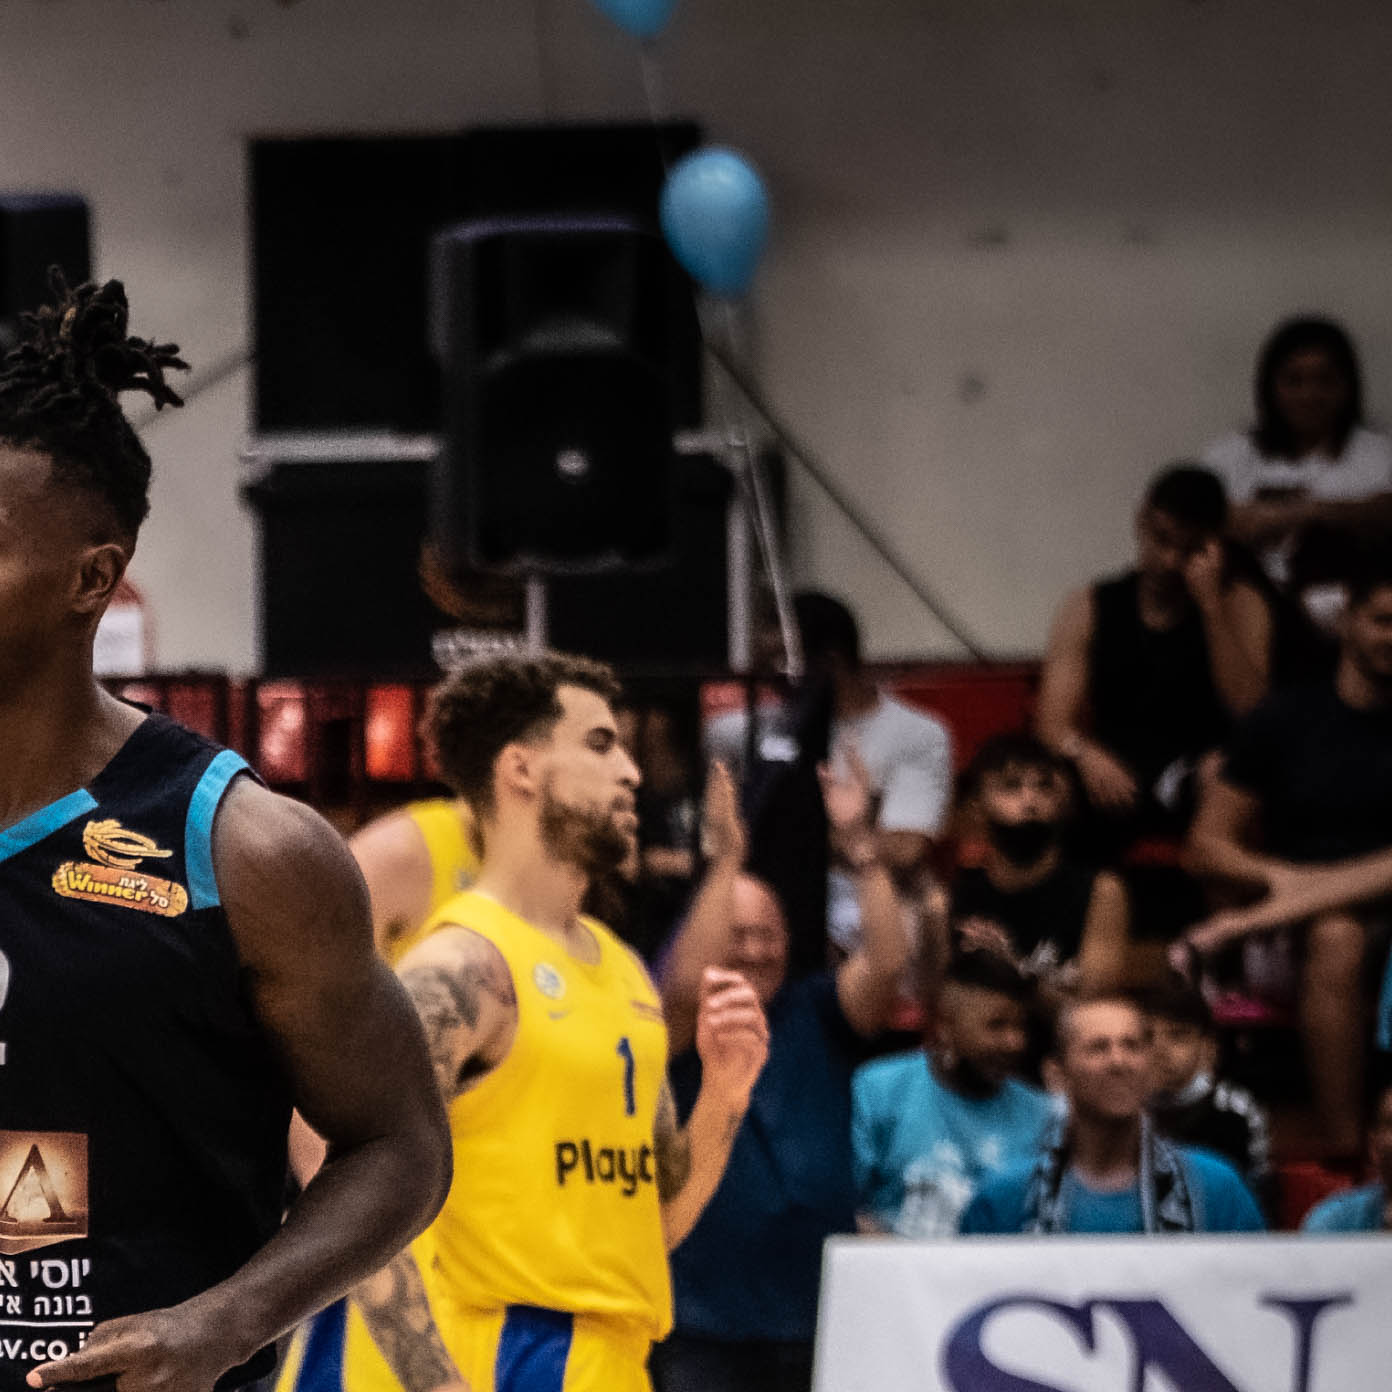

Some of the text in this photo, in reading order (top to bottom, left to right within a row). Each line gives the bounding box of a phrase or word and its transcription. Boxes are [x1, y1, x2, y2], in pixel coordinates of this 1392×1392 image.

[66, 870, 149, 902] Winner
[615, 1036, 636, 1117] 1
[29, 1258, 92, 1289] יוסי
[34, 1294, 93, 1316] בונה
